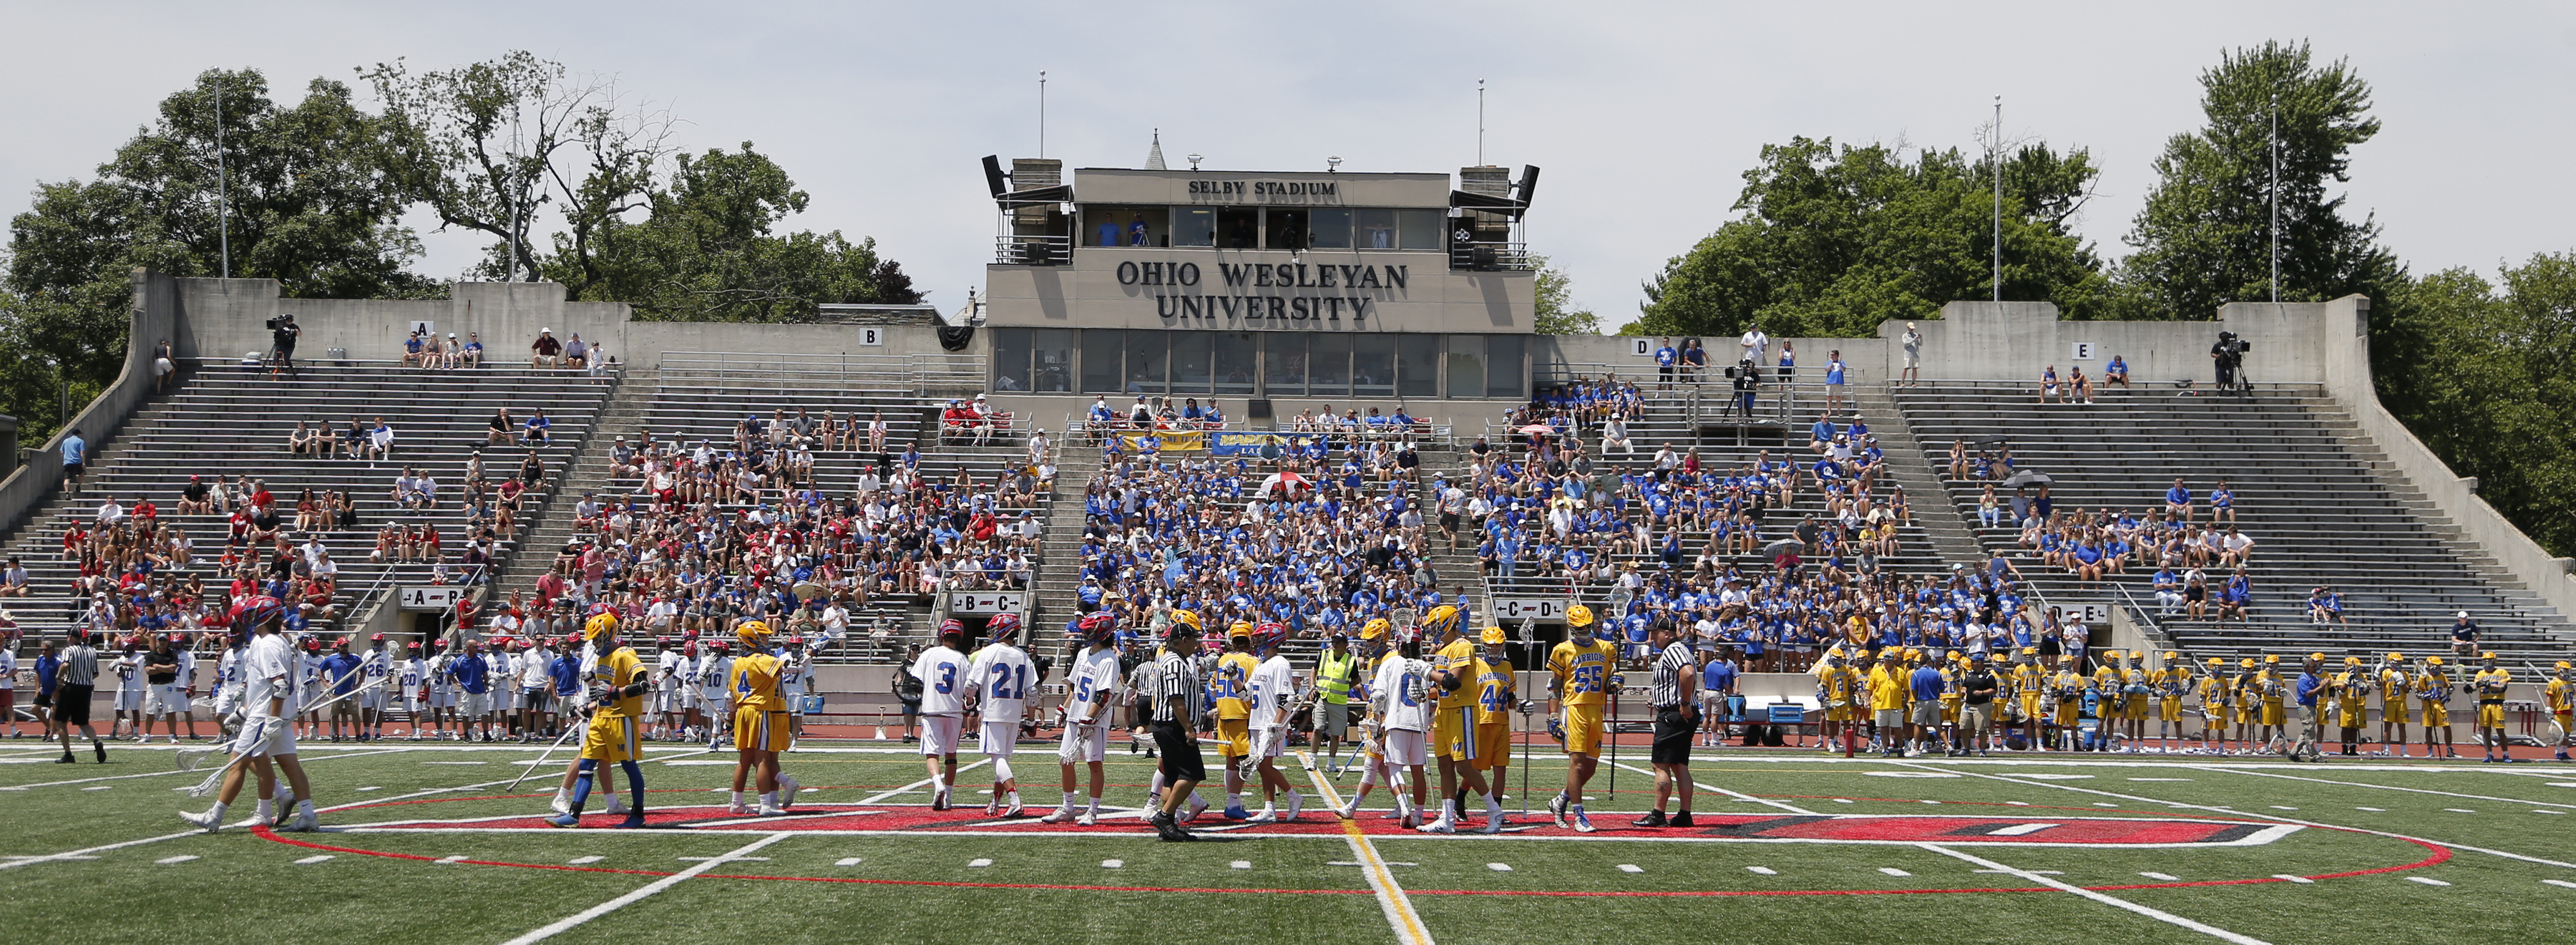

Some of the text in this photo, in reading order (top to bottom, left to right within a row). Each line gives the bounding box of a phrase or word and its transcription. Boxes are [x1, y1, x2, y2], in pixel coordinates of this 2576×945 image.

[1189, 181, 1335, 195] SELBY STADIUM
[1116, 261, 1407, 289] OHIO WESLEYAN
[1156, 295, 1370, 320] UNIVERSITY
[417, 323, 427, 336] A
[867, 330, 875, 343] B
[1639, 341, 1646, 353] D
[2079, 344, 2087, 357] E
[414, 590, 424, 604] A
[966, 596, 1008, 611] B C
[1508, 601, 1551, 616] C D
[2086, 606, 2094, 621] E
[1571, 652, 1605, 667] WARRIORS
[368, 664, 384, 677] 26
[404, 674, 417, 687] 20
[708, 673, 722, 687] 10
[738, 670, 752, 700] 4
[935, 662, 957, 694] 3
[992, 663, 1025, 699] 21
[1477, 672, 1510, 684] WARRIORS
[1574, 665, 1603, 694] 55
[1836, 678, 1843, 692] 2
[2026, 677, 2037, 690] 11
[1480, 684, 1510, 712] 44
